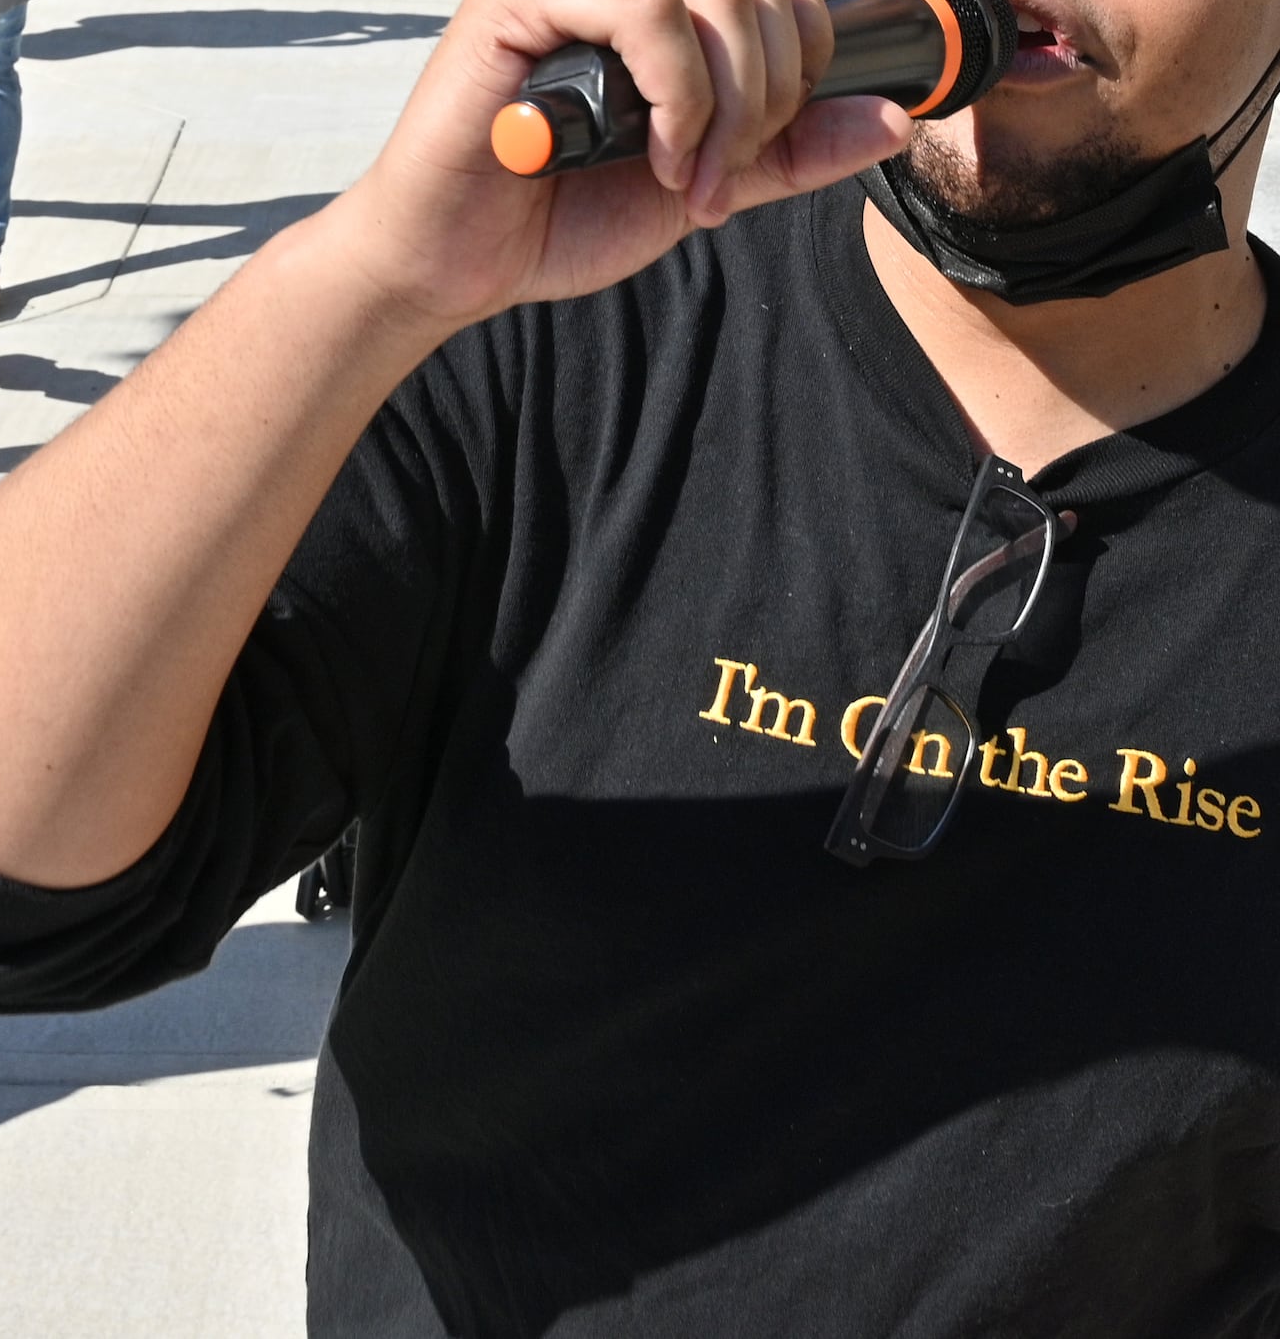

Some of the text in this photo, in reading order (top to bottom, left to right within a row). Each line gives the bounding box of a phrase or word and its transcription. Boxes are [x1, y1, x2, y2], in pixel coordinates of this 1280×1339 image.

[699, 657, 816, 747] I'm
[978, 726, 1088, 803] the
[1109, 747, 1262, 839] Rise
